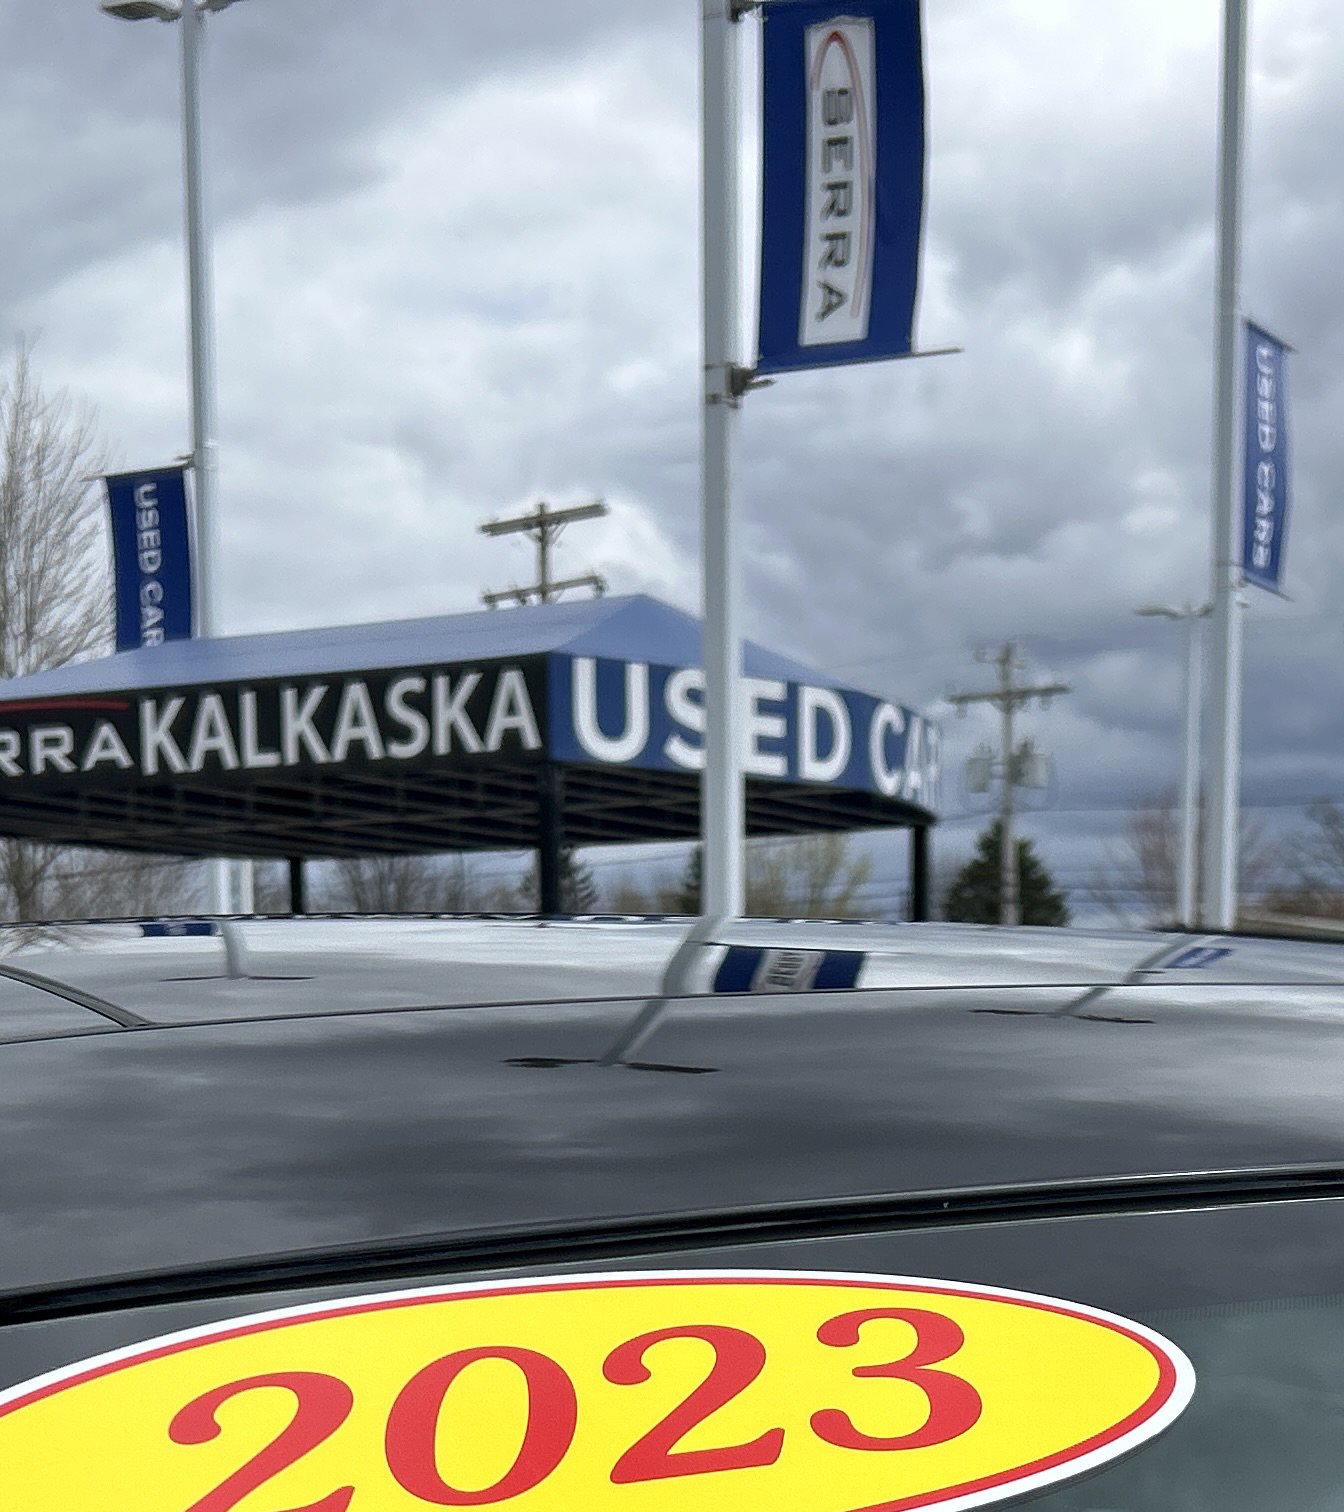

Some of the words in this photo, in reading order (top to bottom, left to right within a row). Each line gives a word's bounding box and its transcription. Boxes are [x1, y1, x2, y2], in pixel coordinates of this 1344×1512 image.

[816, 88, 854, 322] SERRA
[1255, 344, 1277, 453] USED
[134, 482, 162, 574] USED
[1252, 461, 1275, 569] CARS
[139, 665, 543, 776] KALKASKA
[571, 657, 853, 782] USED
